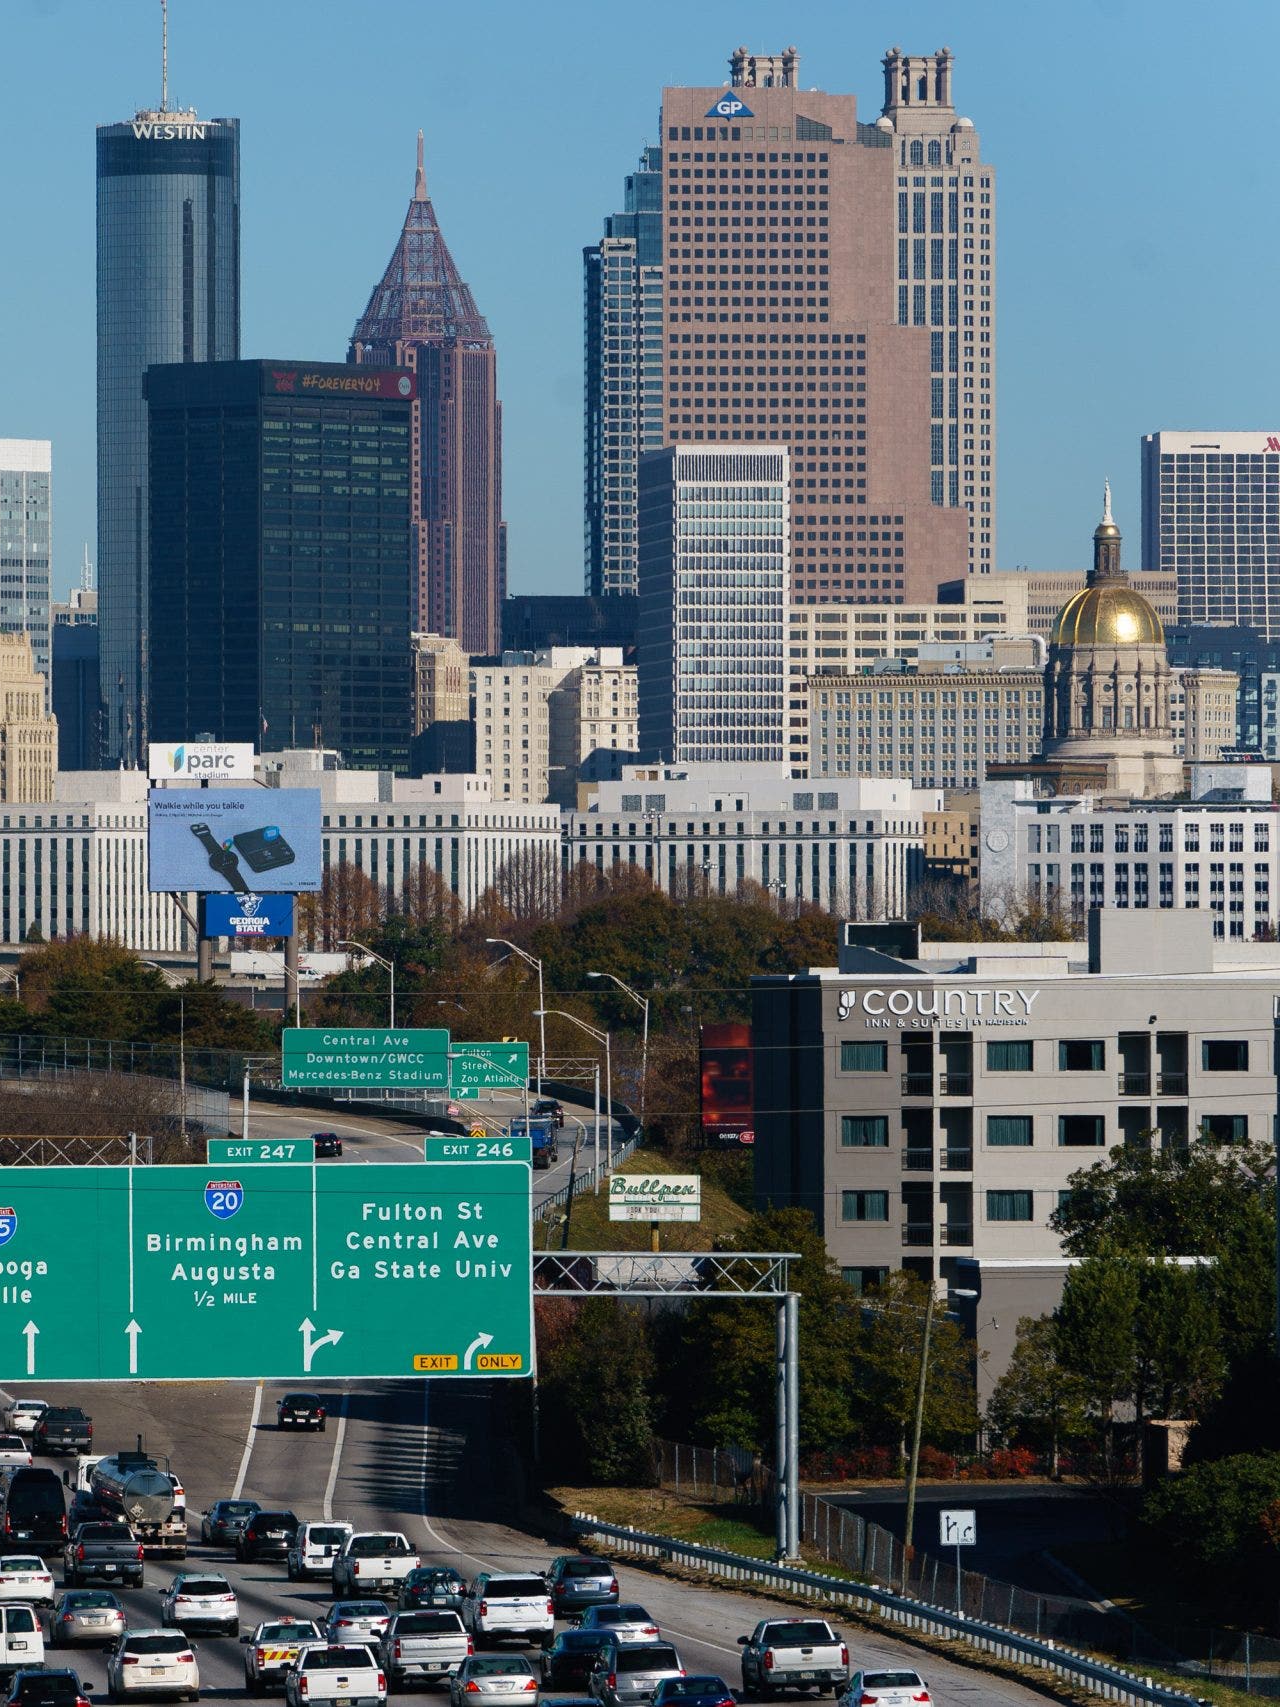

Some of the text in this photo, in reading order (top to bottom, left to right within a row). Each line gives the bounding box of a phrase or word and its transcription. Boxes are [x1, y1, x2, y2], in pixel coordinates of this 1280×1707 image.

[717, 101, 743, 115] GP
[132, 123, 205, 140] WESTIN
[302, 373, 381, 391] #FOREVER404
[187, 754, 235, 773] parc
[194, 771, 229, 779] stadium
[154, 802, 245, 811] Walkie while you talkie
[229, 917, 270, 925] GEORGIA
[235, 925, 264, 933] STATE
[865, 1018, 1030, 1028] INN & SUITES BY RADISSON
[323, 1035, 409, 1046] Central Ave
[306, 1052, 425, 1064] Downtown/GWCC
[461, 1048, 492, 1057] Fulton
[461, 1061, 492, 1070] Street
[288, 1069, 443, 1080] Mercedes-Benz Stadium
[461, 1074, 479, 1083] Zoo
[227, 1144, 296, 1159] EXIT 247
[443, 1143, 514, 1158] EXIT 246
[610, 1177, 696, 1201] Bullpen
[212, 1191, 238, 1210] 20
[362, 1202, 483, 1221] Fulton St
[146, 1233, 303, 1257] Birmingham
[346, 1231, 499, 1250] Central Ave
[171, 1262, 276, 1286] Augusta
[330, 1260, 513, 1279] Ga State Univ
[223, 1292, 257, 1304] MILE
[420, 1357, 452, 1368] EXIT
[479, 1357, 519, 1368] ONLY
